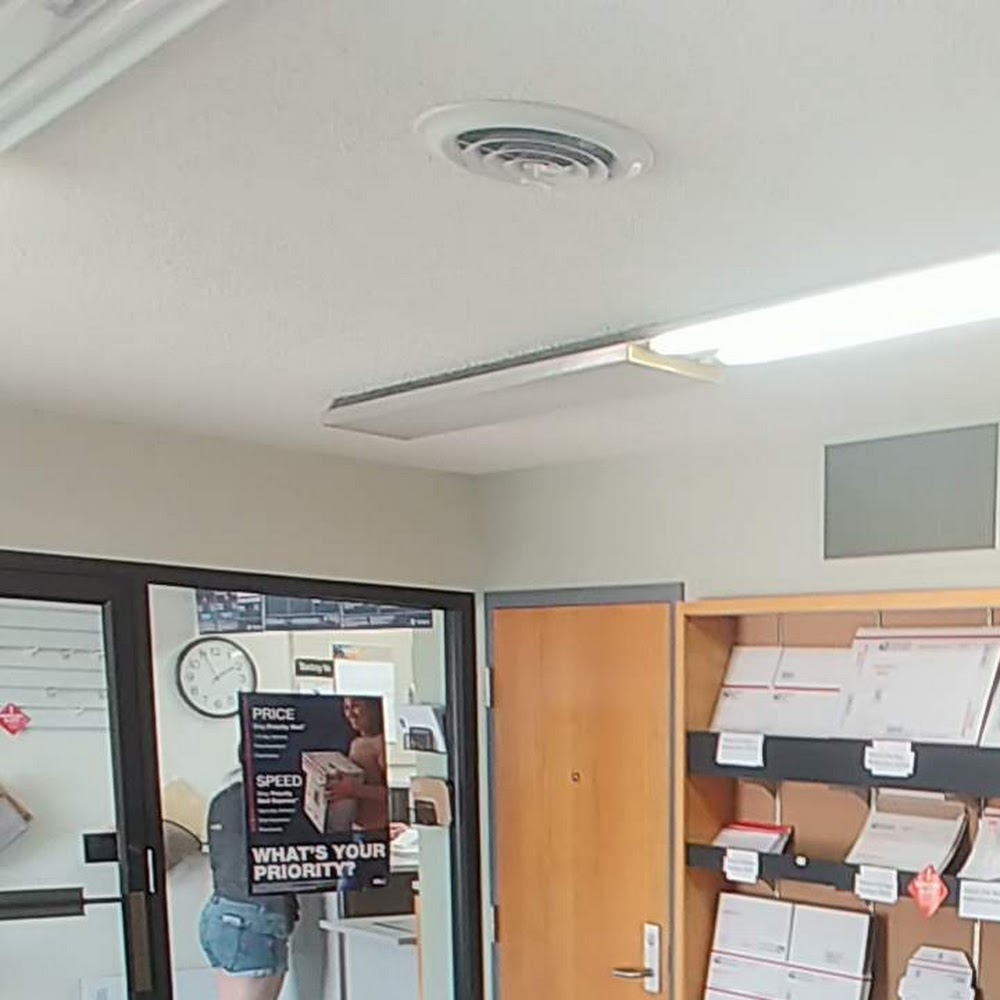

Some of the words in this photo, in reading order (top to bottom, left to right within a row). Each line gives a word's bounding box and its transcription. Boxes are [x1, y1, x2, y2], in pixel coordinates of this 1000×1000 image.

[252, 707, 296, 721] PRICE
[256, 774, 303, 788] SPEED
[251, 844, 328, 863] WHAT'S
[331, 842, 387, 860] YOUR
[253, 860, 356, 881] PRIORITY?
